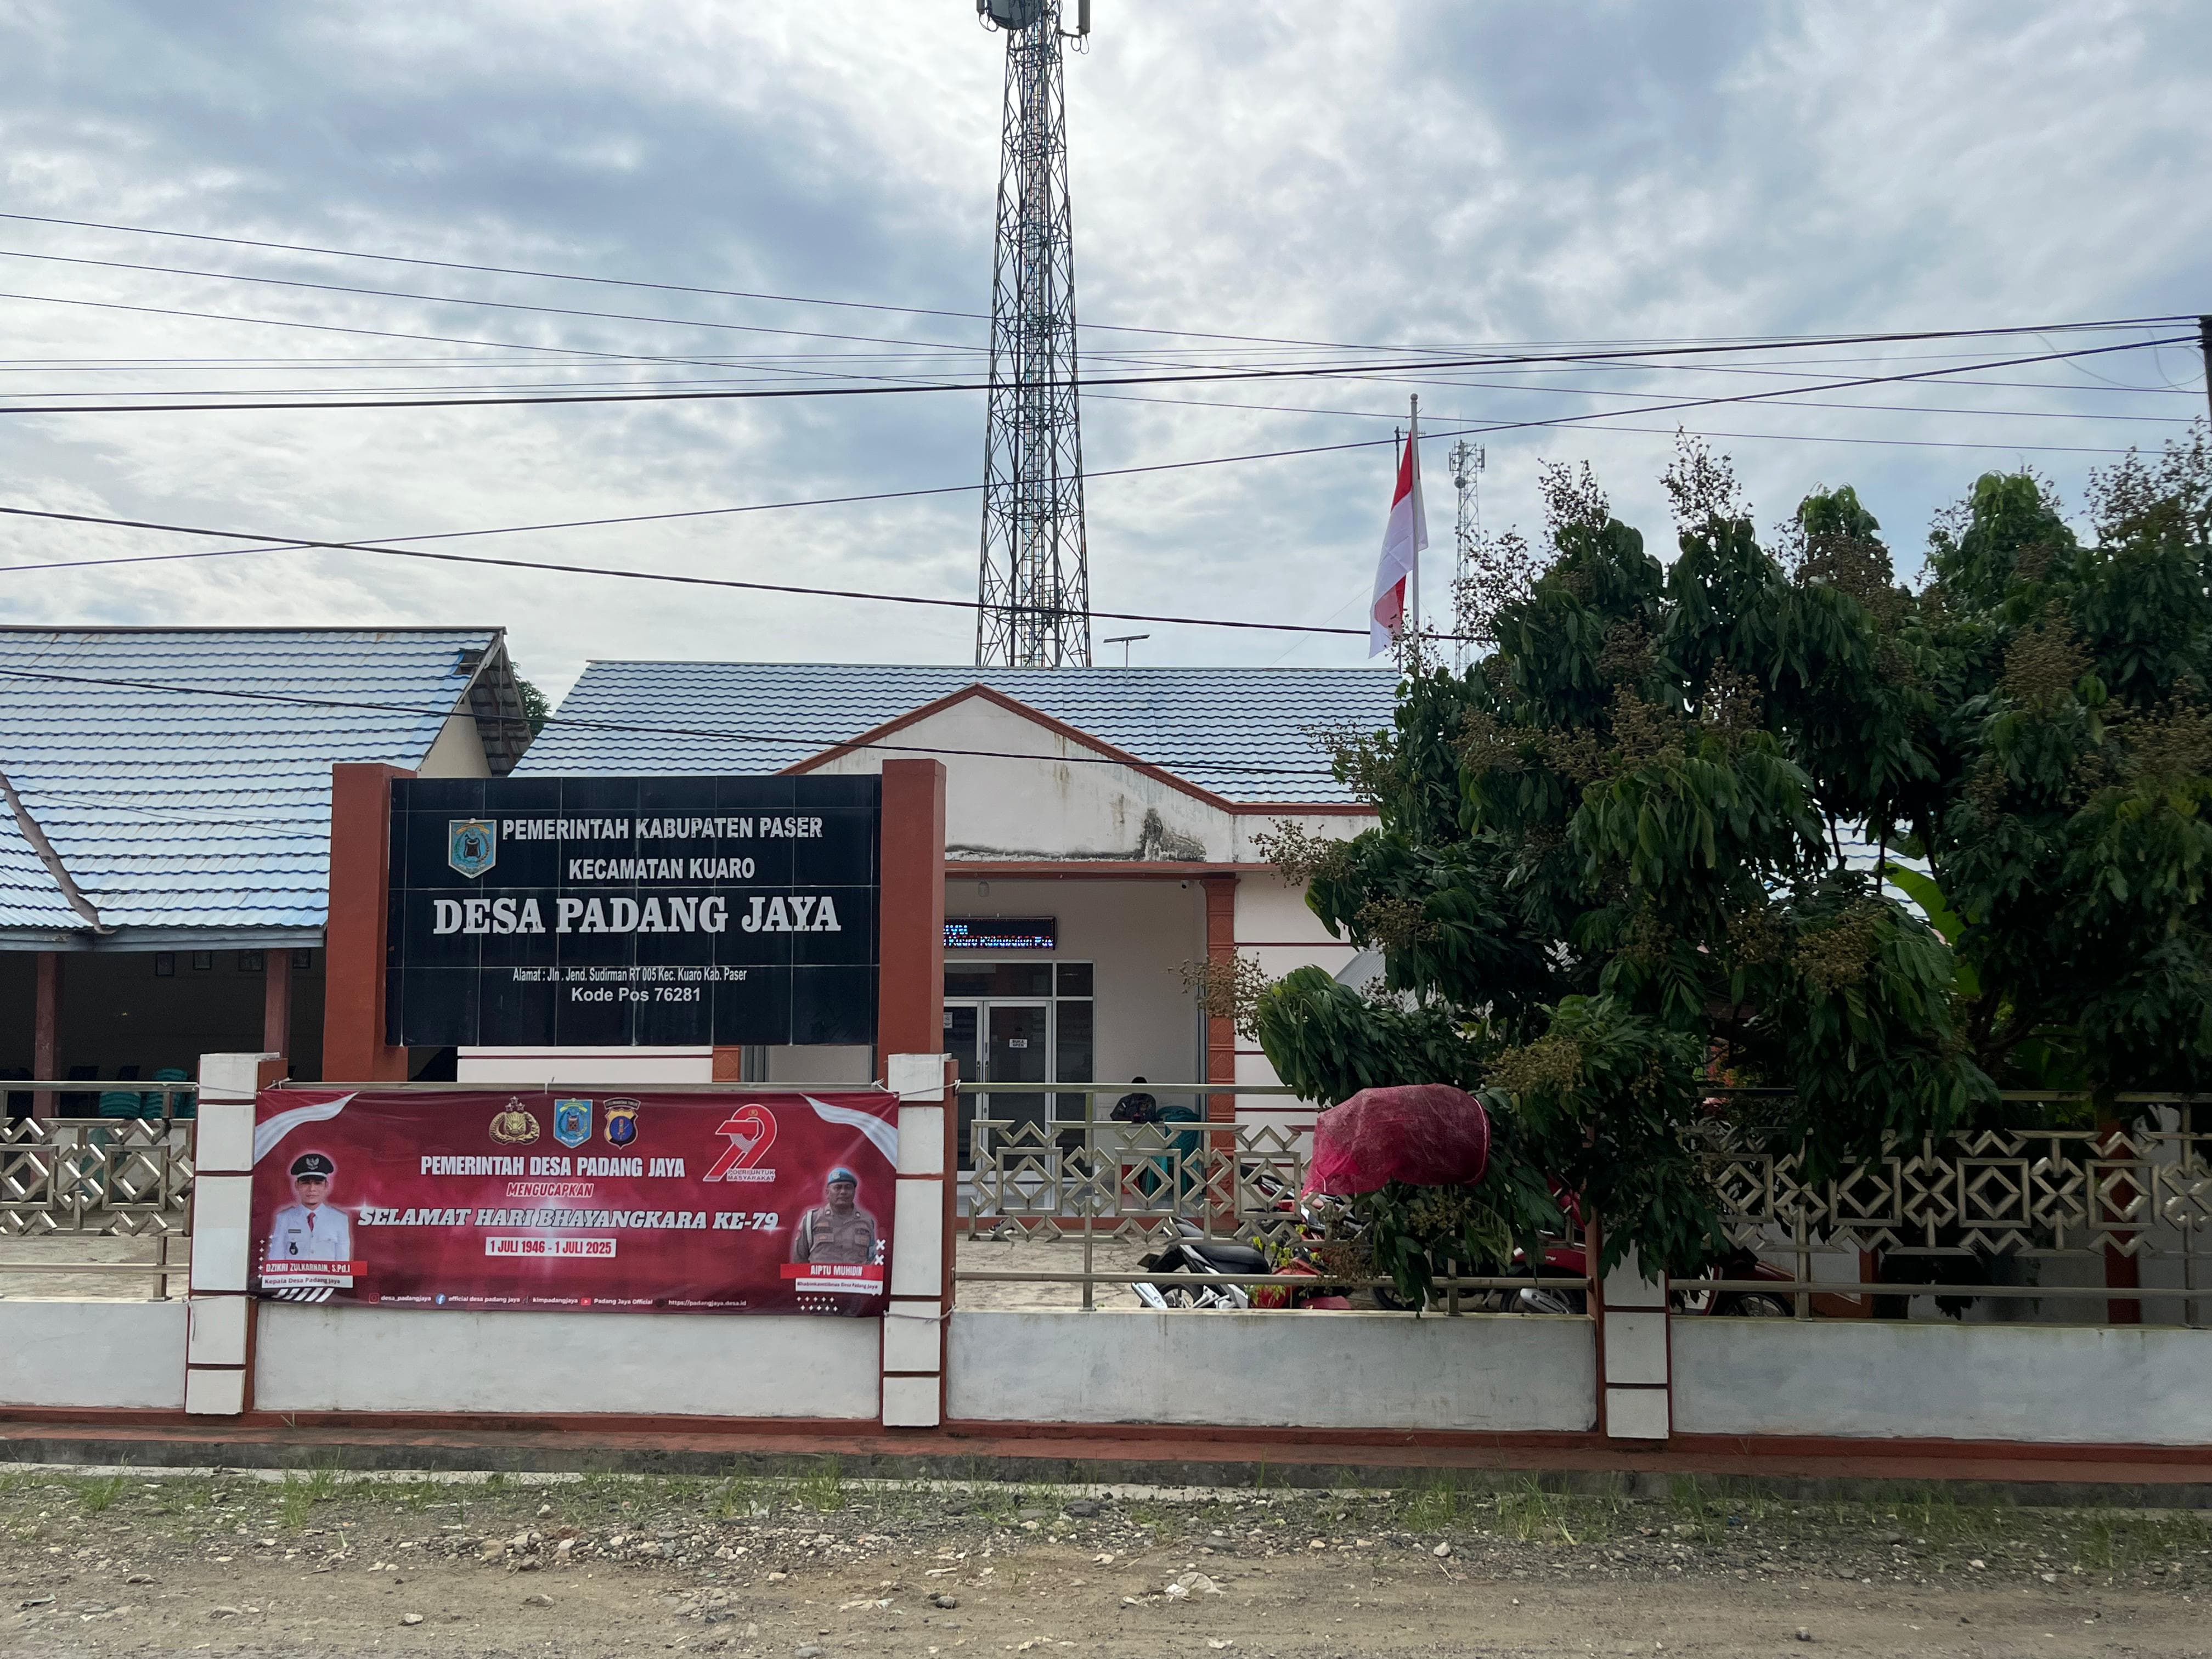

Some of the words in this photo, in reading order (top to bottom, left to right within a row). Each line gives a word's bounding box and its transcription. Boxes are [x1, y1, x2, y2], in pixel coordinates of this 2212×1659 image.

[503, 819, 629, 840] PEMERINTAH
[635, 817, 753, 839] KABUPATEN
[760, 817, 823, 838] PASER
[569, 858, 684, 879] KECAMATAN
[690, 857, 755, 879] KUARO
[433, 898, 546, 934] DESA
[555, 896, 729, 933] PADANG
[741, 896, 842, 933] JAYA
[513, 967, 541, 981] Alamat
[566, 967, 588, 981] Jend.
[589, 967, 628, 981] Sudirman
[629, 967, 640, 981] RT
[642, 967, 657, 981] 005
[658, 967, 676, 981] Kec.
[678, 967, 702, 981] Kuaro
[704, 967, 722, 981] Kab.
[724, 967, 747, 981] Paser
[571, 987, 614, 1002] Kode
[618, 987, 650, 1002] Pos
[654, 987, 700, 1002] 76281
[420, 1155, 524, 1176] PEMERINTAH
[529, 1156, 572, 1176] DESA
[577, 1157, 643, 1177] PADANG
[648, 1158, 685, 1177] JAYA
[506, 1182, 594, 1198] MENGUCAPKAN
[357, 1208, 472, 1226] SELAMAT
[473, 1208, 535, 1227] HARI
[535, 1209, 707, 1229] BHAYANGKARA
[712, 1211, 779, 1231] KE-79
[490, 1240, 495, 1253] 1
[498, 1240, 518, 1253] JULI
[521, 1240, 545, 1253] 1946
[555, 1240, 560, 1254] 1
[562, 1241, 583, 1254] JULI
[586, 1242, 612, 1255] 2025
[810, 1265, 832, 1276] AIPTU
[833, 1265, 863, 1276] MUHIDIN
